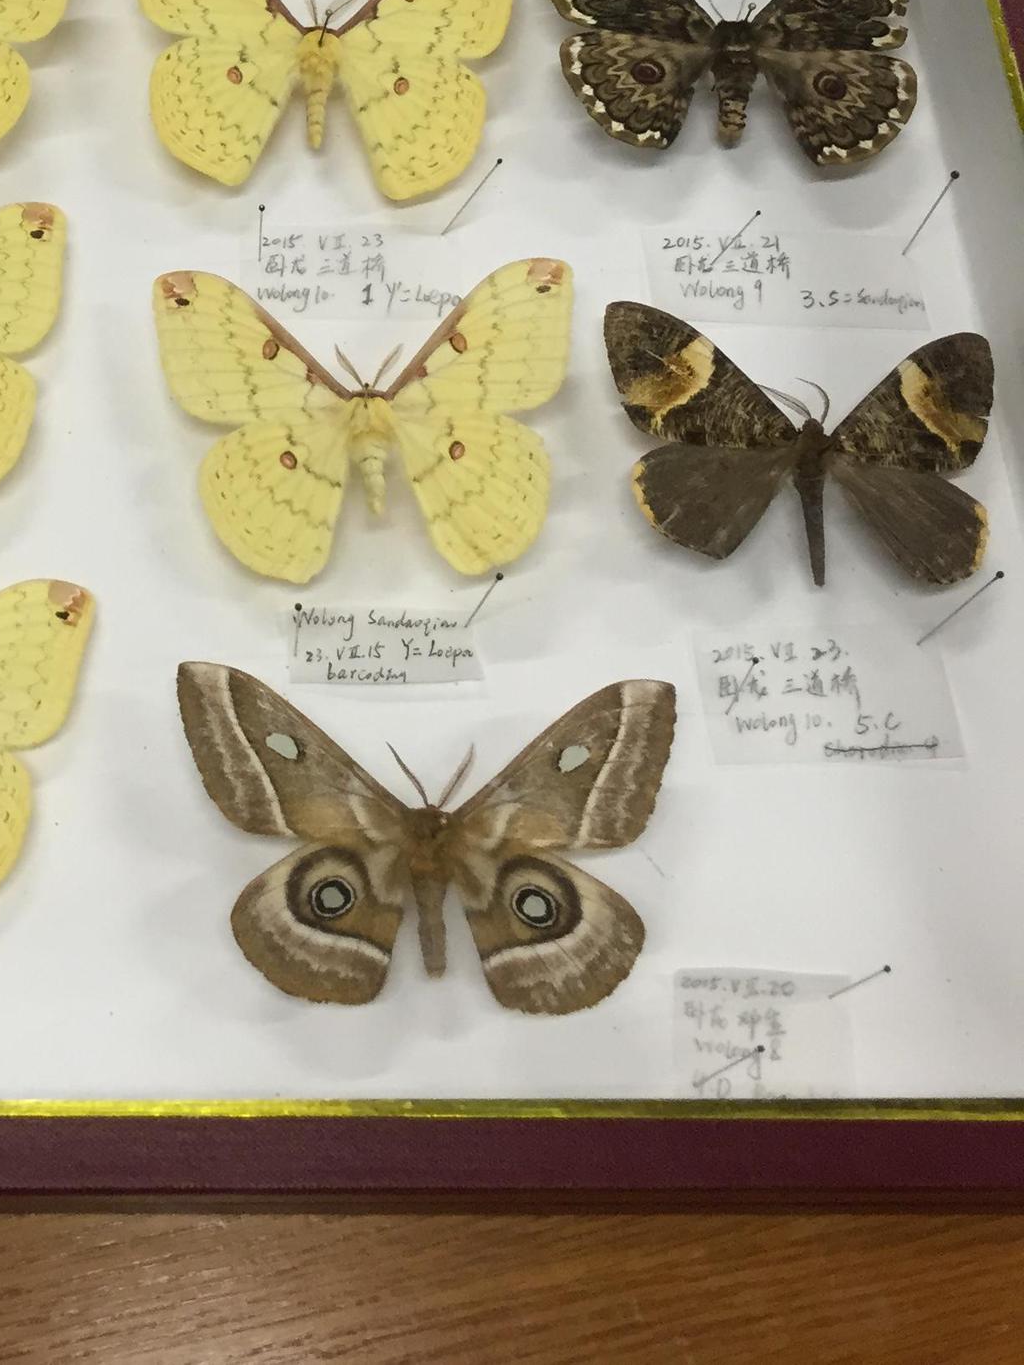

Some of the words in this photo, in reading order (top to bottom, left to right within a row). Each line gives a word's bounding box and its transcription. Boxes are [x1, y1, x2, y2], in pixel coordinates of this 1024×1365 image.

[262, 233, 303, 249] 2015
[361, 233, 385, 248] 23
[761, 234, 780, 252] 21
